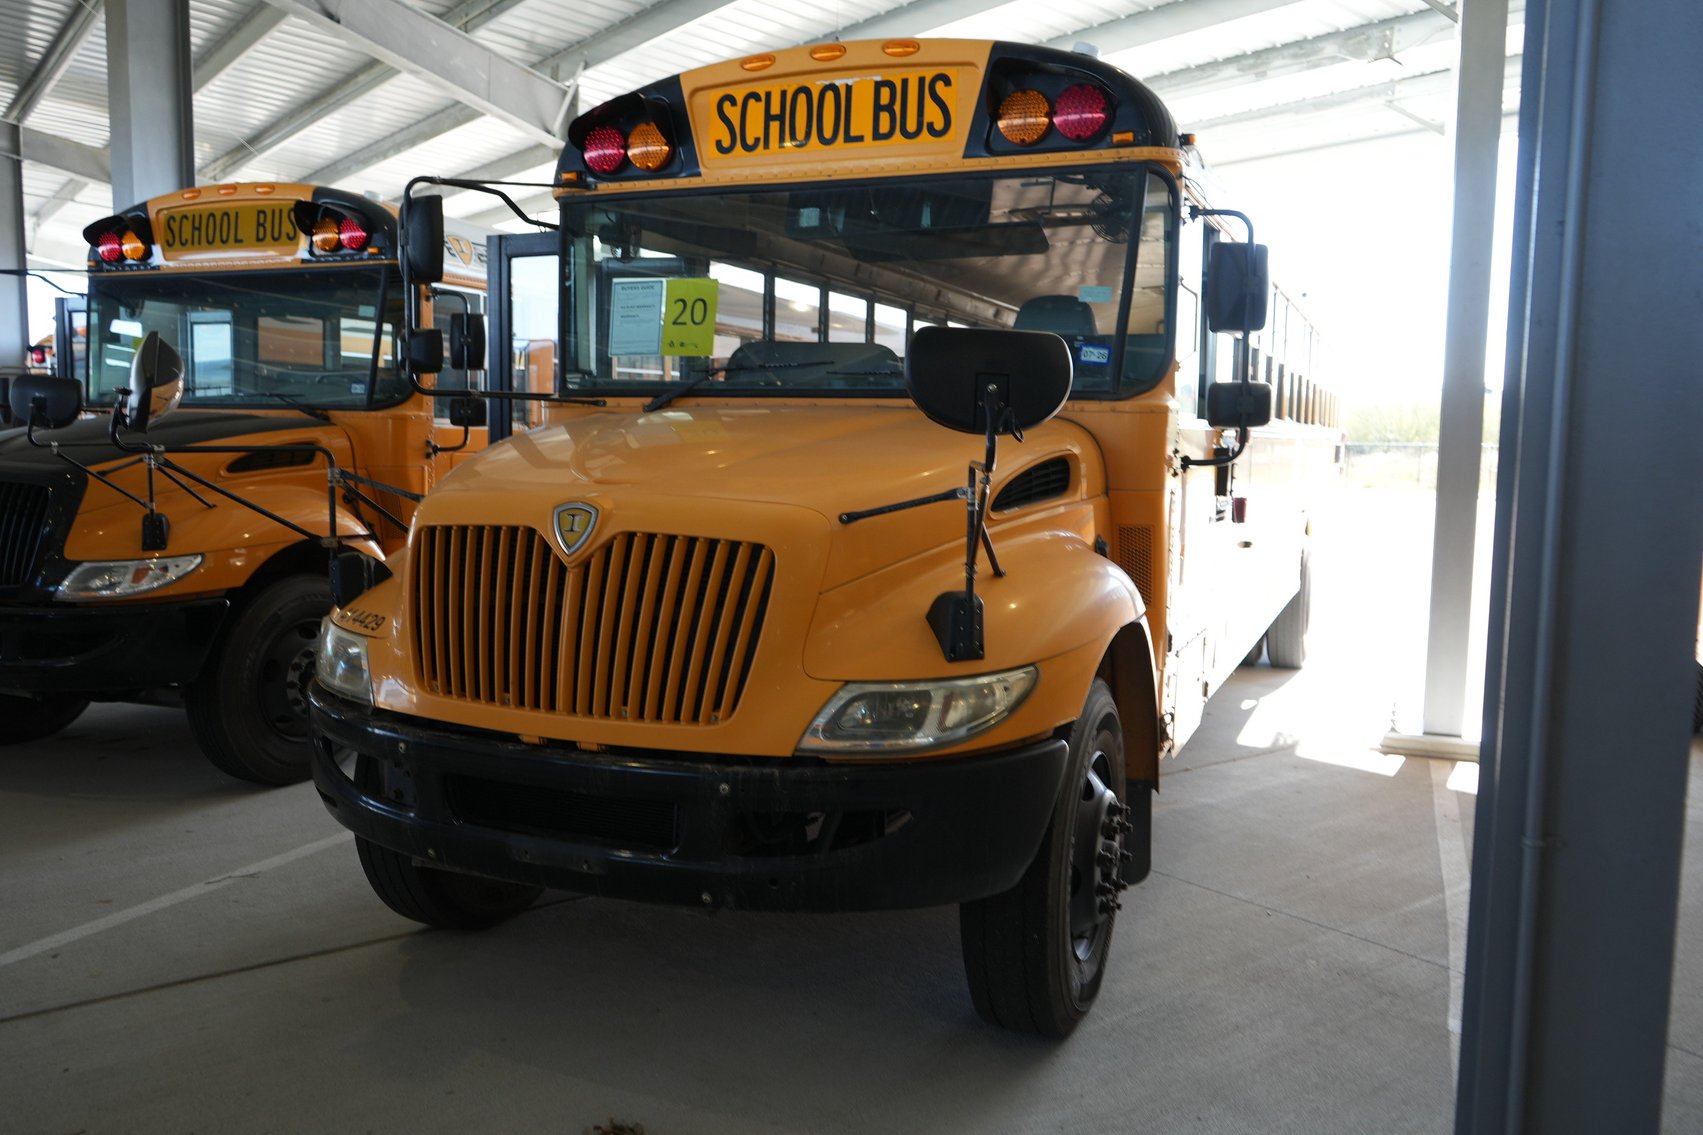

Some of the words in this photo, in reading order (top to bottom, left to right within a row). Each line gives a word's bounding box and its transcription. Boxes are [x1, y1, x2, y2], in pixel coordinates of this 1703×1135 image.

[715, 83, 864, 155] SCHOOL
[872, 73, 952, 141] BUS
[166, 211, 243, 248] SCHOOL
[255, 207, 297, 242] BUS
[672, 298, 708, 326] 20
